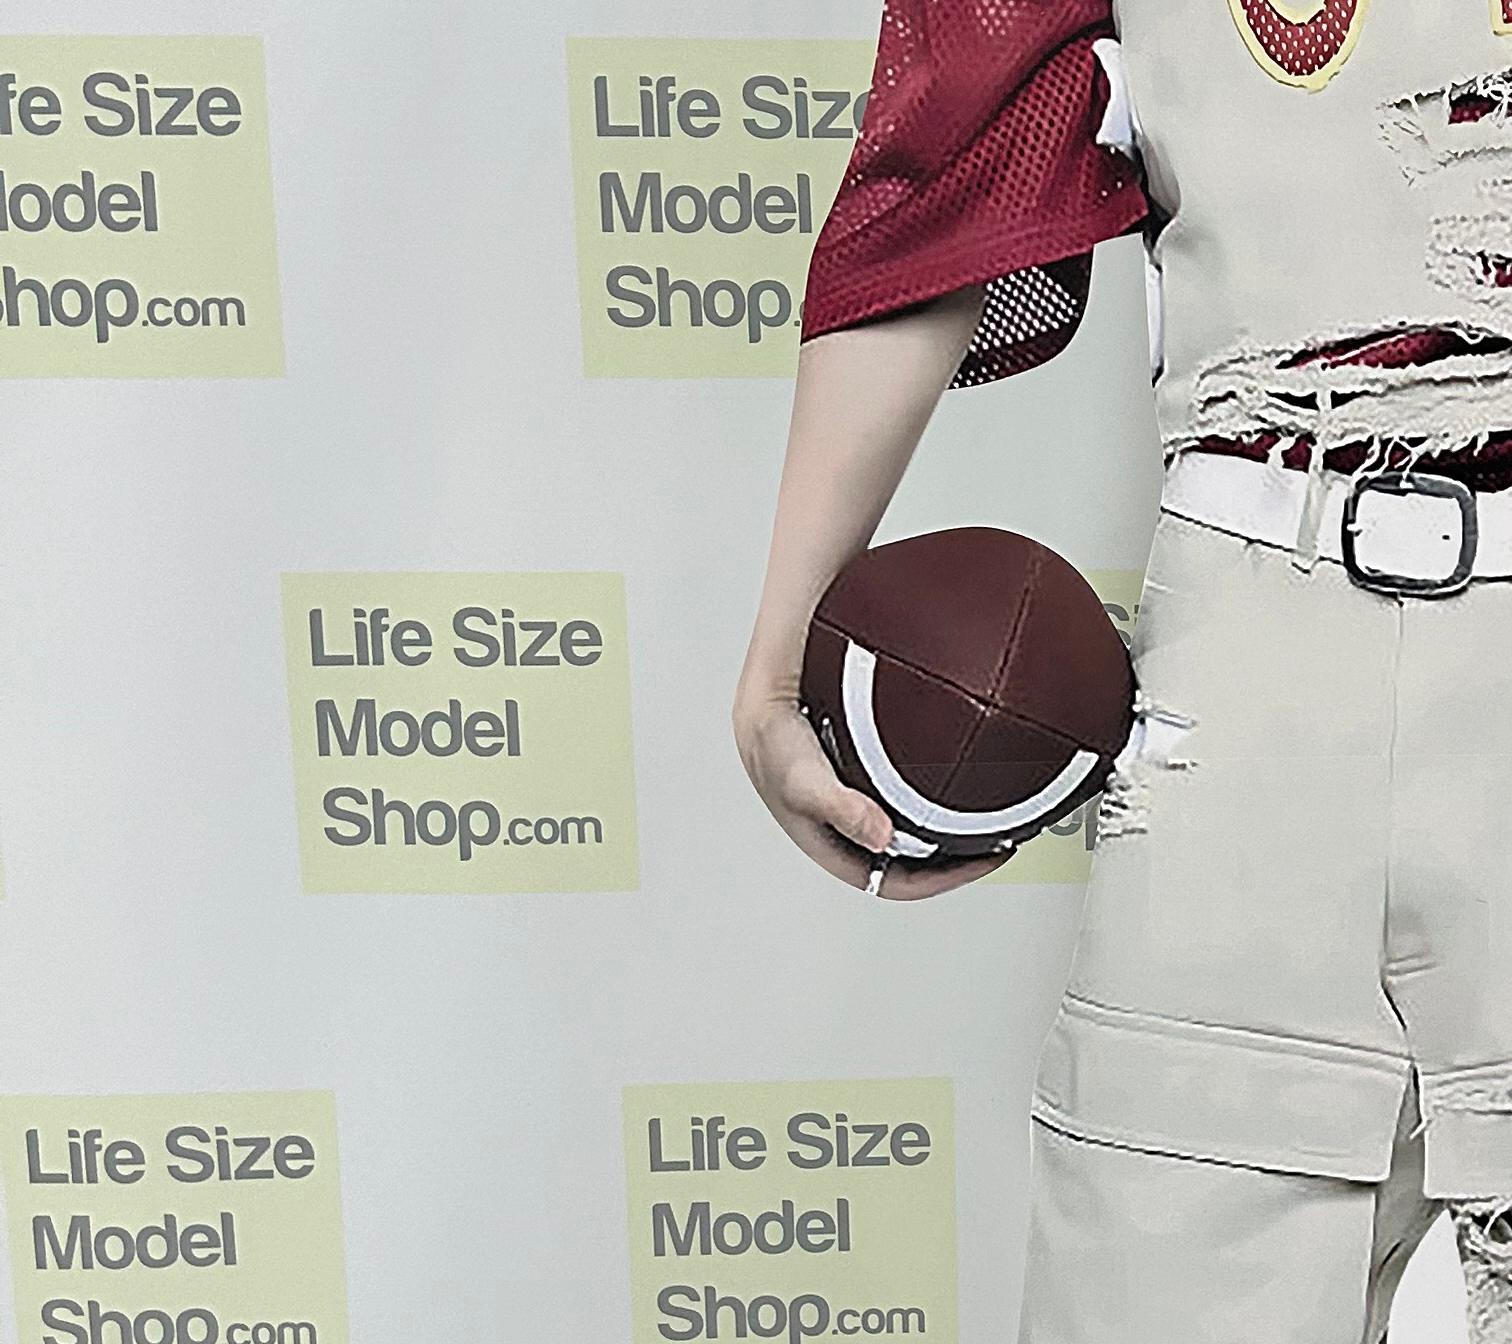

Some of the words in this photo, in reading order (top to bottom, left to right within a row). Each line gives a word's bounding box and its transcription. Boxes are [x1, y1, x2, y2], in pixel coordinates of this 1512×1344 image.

[0, 74, 61, 135] fe
[83, 72, 241, 137] Size
[594, 76, 720, 138] Life
[0, 171, 158, 232] odel
[600, 172, 812, 234] Model
[0, 266, 245, 343] hop.com
[606, 266, 804, 344] Shop.
[309, 608, 432, 666] Life
[453, 607, 602, 667] Size
[315, 699, 520, 757] Model
[323, 787, 602, 861] Shop.com
[26, 1129, 145, 1184] Life
[165, 1126, 315, 1183] Size
[648, 1116, 767, 1172] Life
[787, 1113, 930, 1169] Size
[32, 1212, 236, 1270] Model
[652, 1198, 850, 1257] Model
